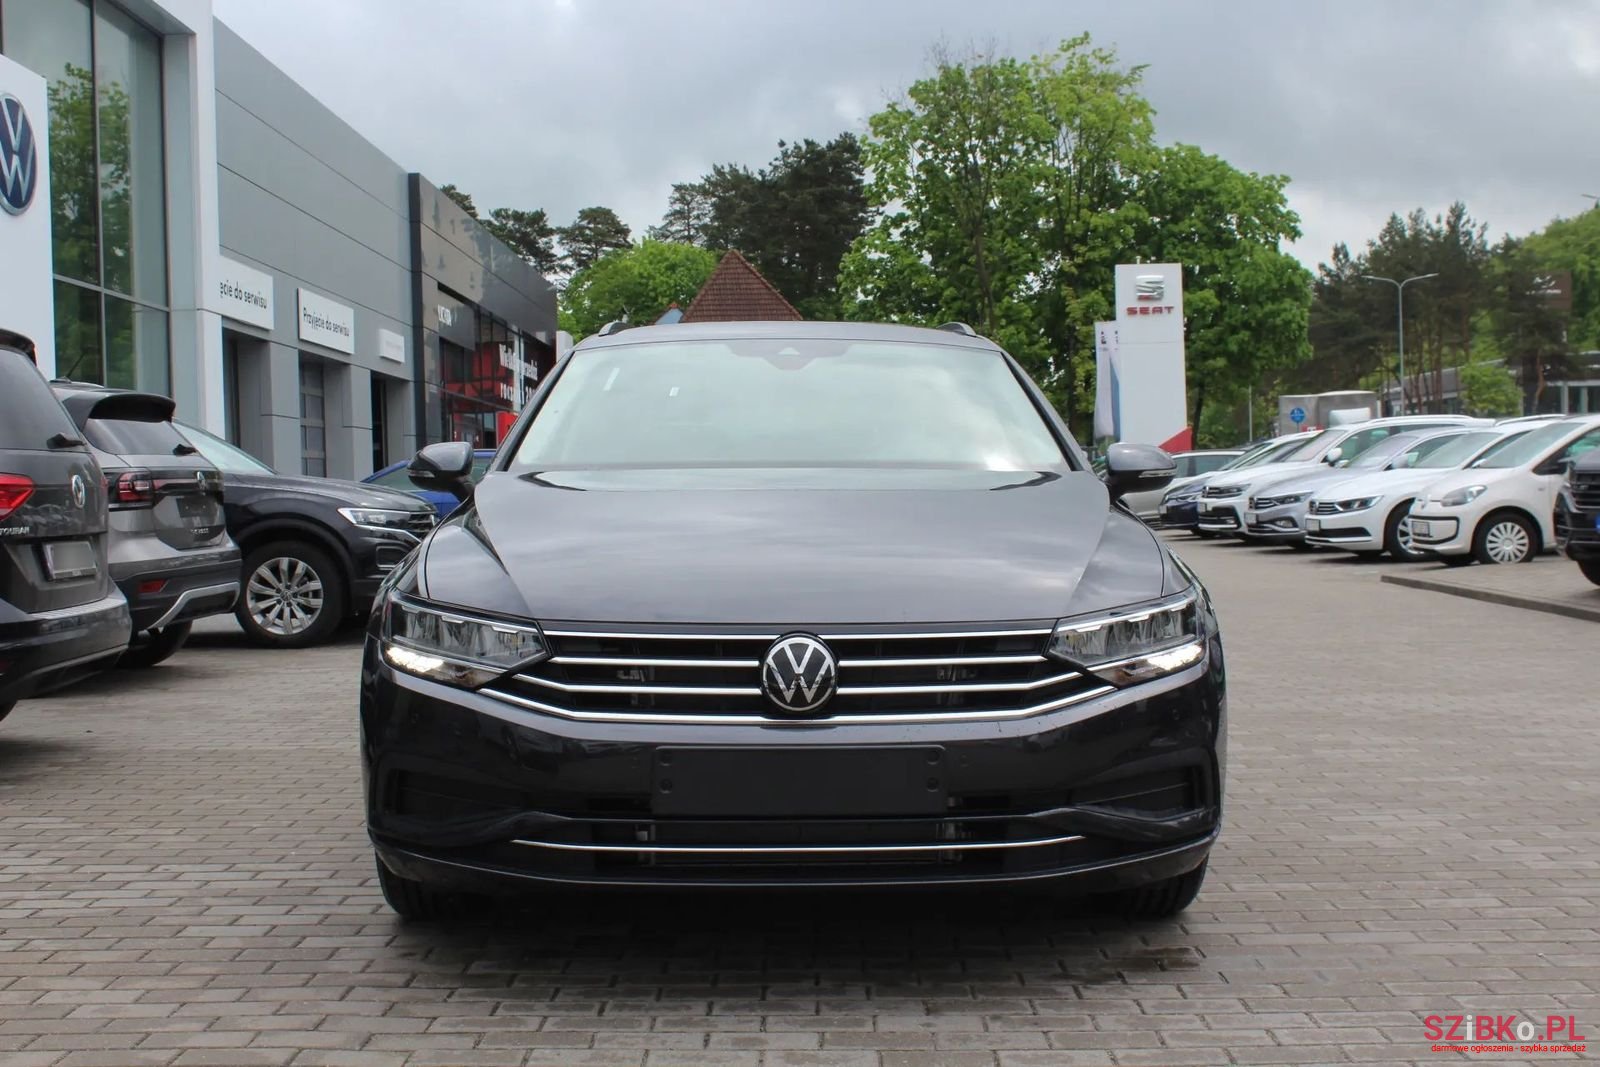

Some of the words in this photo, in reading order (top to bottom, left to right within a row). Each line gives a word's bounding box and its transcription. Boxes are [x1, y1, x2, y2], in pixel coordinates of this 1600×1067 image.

[234, 282, 243, 301] do
[244, 291, 268, 310] serwisu
[1126, 306, 1175, 316] SEAT
[325, 314, 332, 331] do
[332, 322, 350, 337] serwisu
